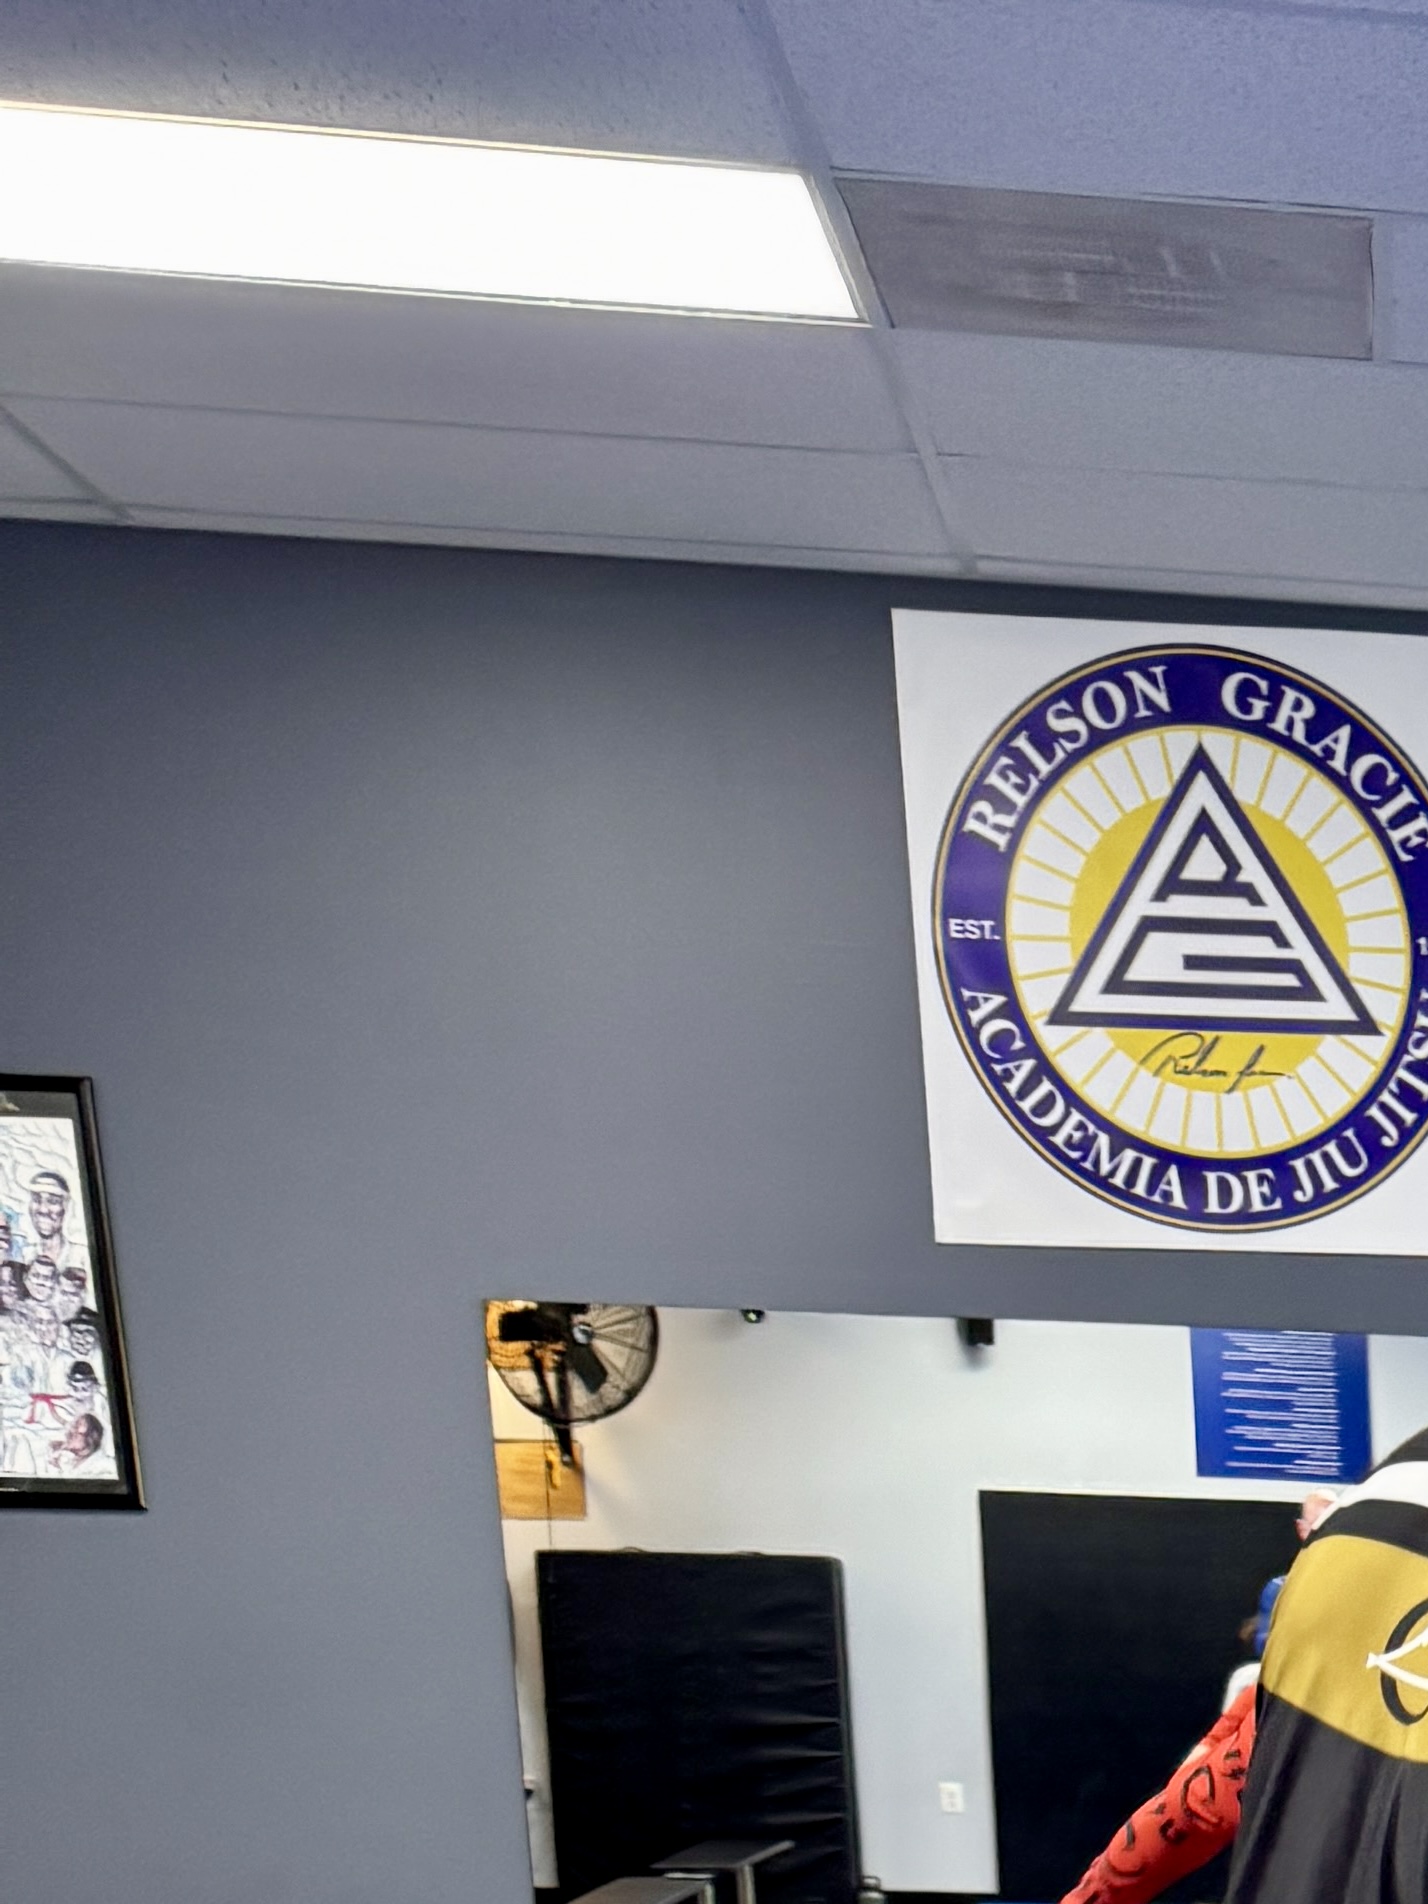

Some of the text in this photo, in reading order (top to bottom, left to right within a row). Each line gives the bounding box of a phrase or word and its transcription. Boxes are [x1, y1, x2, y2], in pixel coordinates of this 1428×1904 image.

[962, 665, 1172, 852] RELSON
[949, 919, 1001, 941] EST.
[961, 988, 1190, 1210] ACADEMIA
[1203, 1170, 1284, 1215] DE
[1292, 1128, 1371, 1201] JIU
